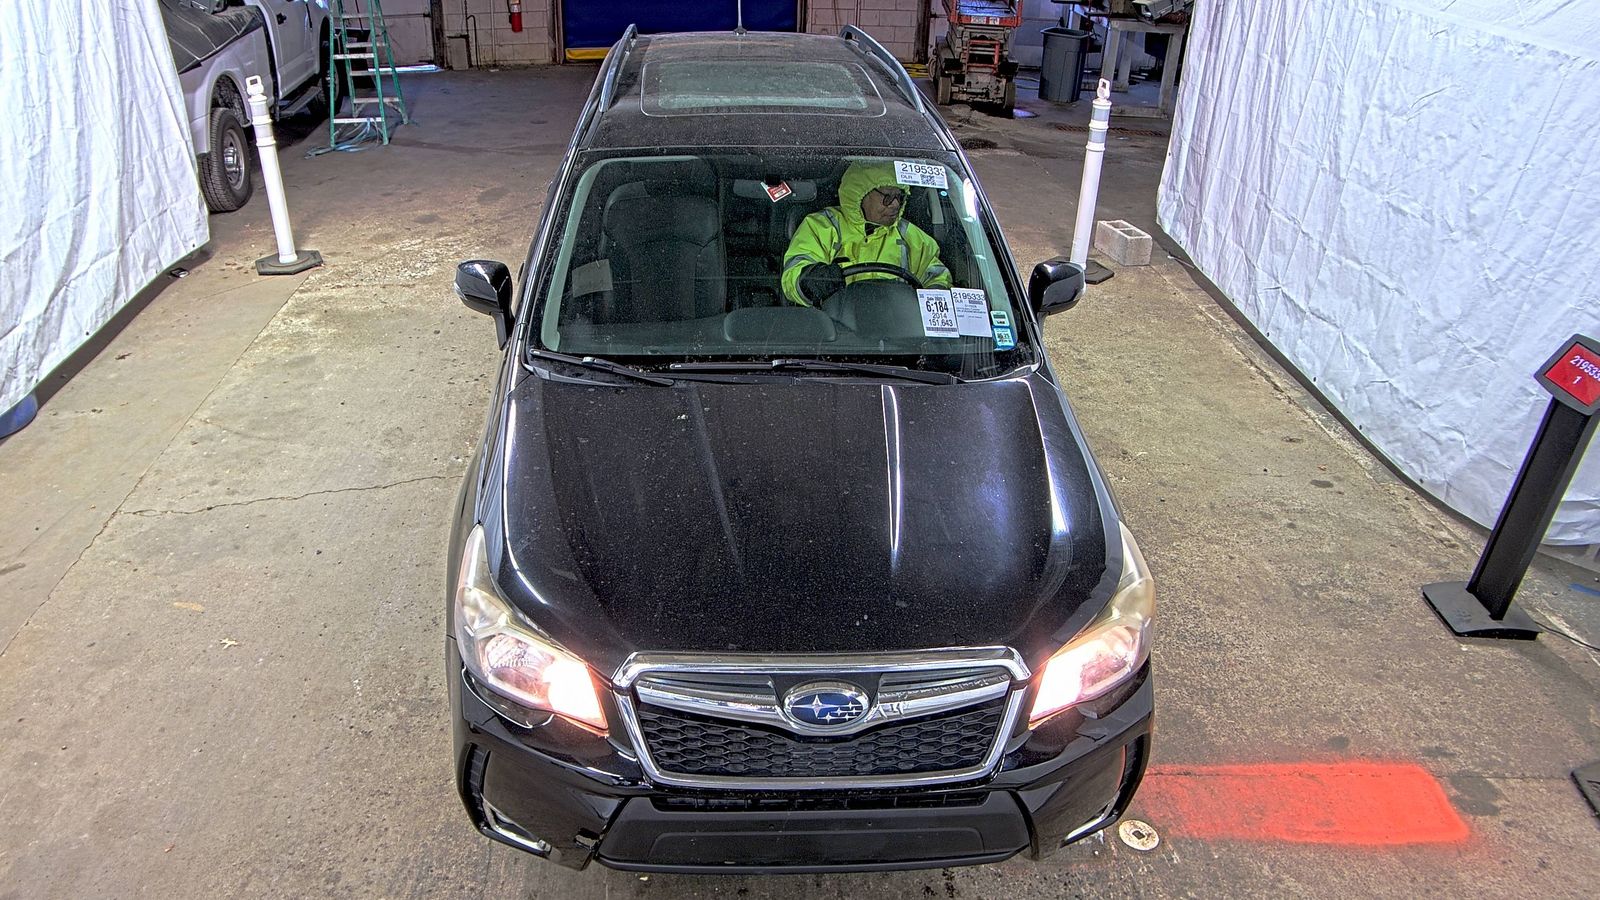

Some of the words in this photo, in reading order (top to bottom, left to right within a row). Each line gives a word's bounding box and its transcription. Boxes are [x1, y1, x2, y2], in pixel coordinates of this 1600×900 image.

[901, 163, 944, 176] 2195333
[926, 301, 949, 312] 6:184
[1573, 376, 1582, 384] 1
